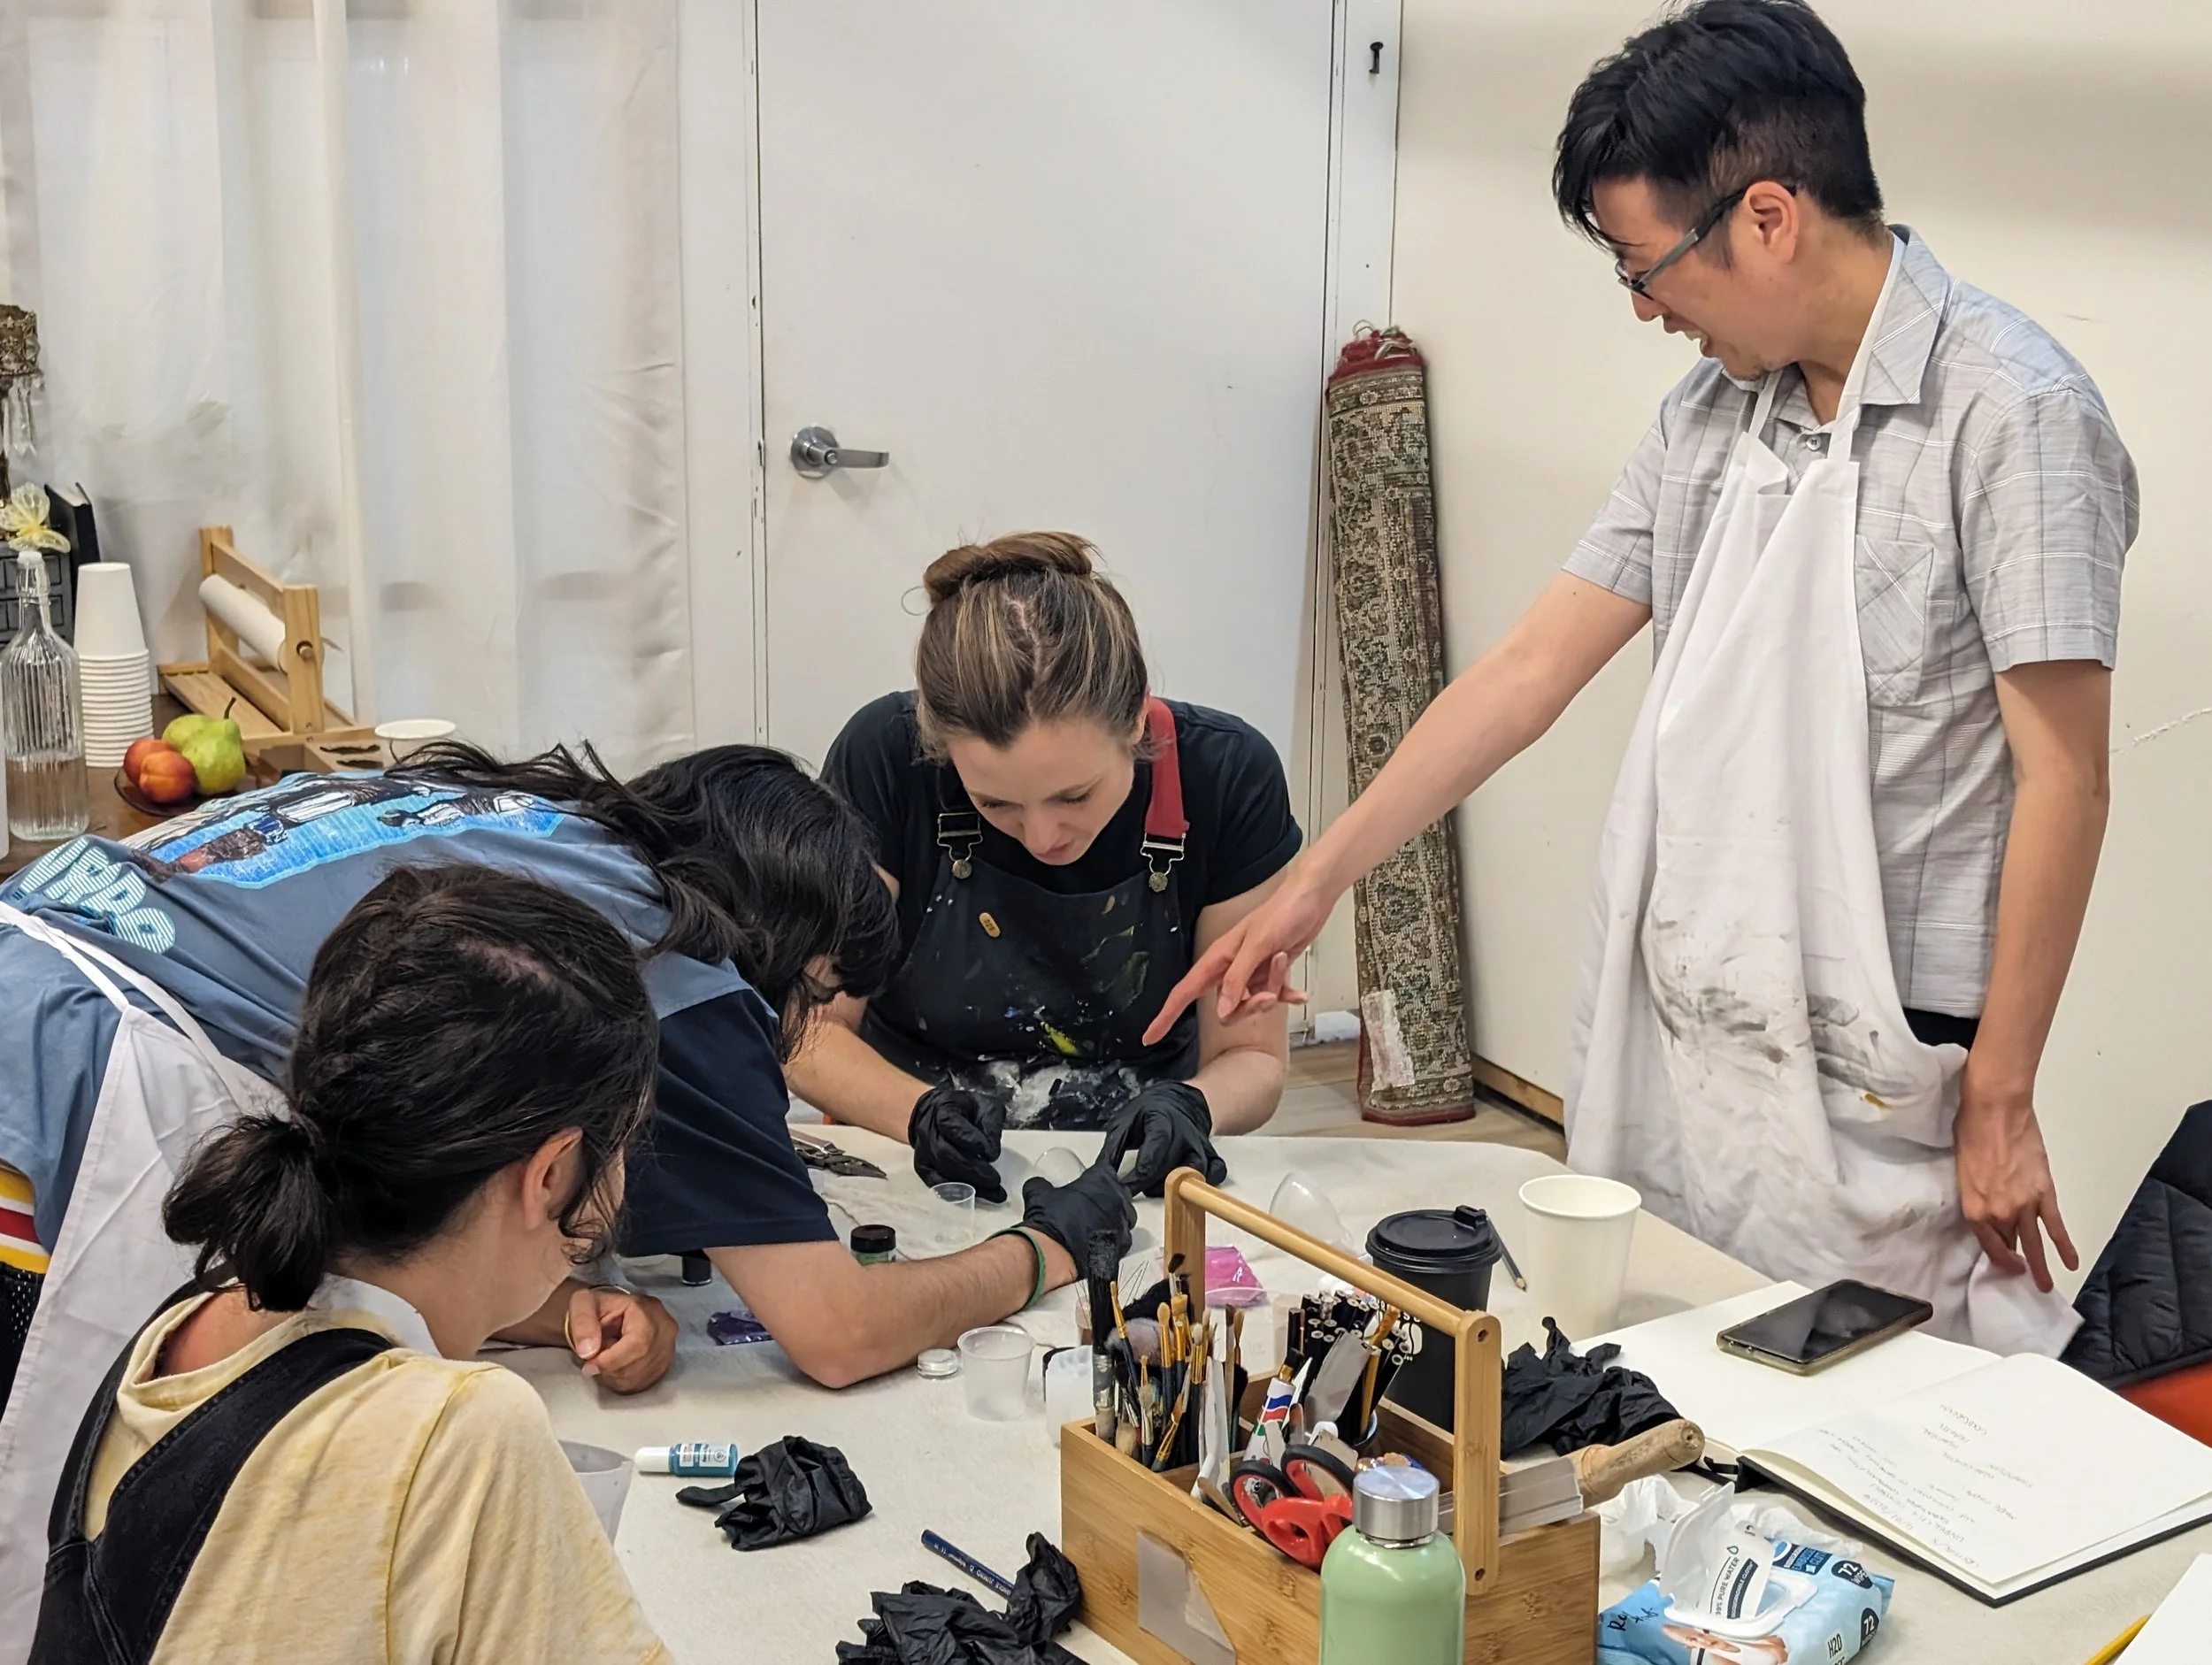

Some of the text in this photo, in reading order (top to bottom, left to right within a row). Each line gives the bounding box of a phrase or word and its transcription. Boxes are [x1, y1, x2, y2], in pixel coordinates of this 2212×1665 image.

[1717, 1580, 1728, 1601] PURE
[1724, 1557, 1740, 1581] WATER
[1838, 1562, 1859, 1577] 72
[1863, 1615, 1875, 1636] 72
